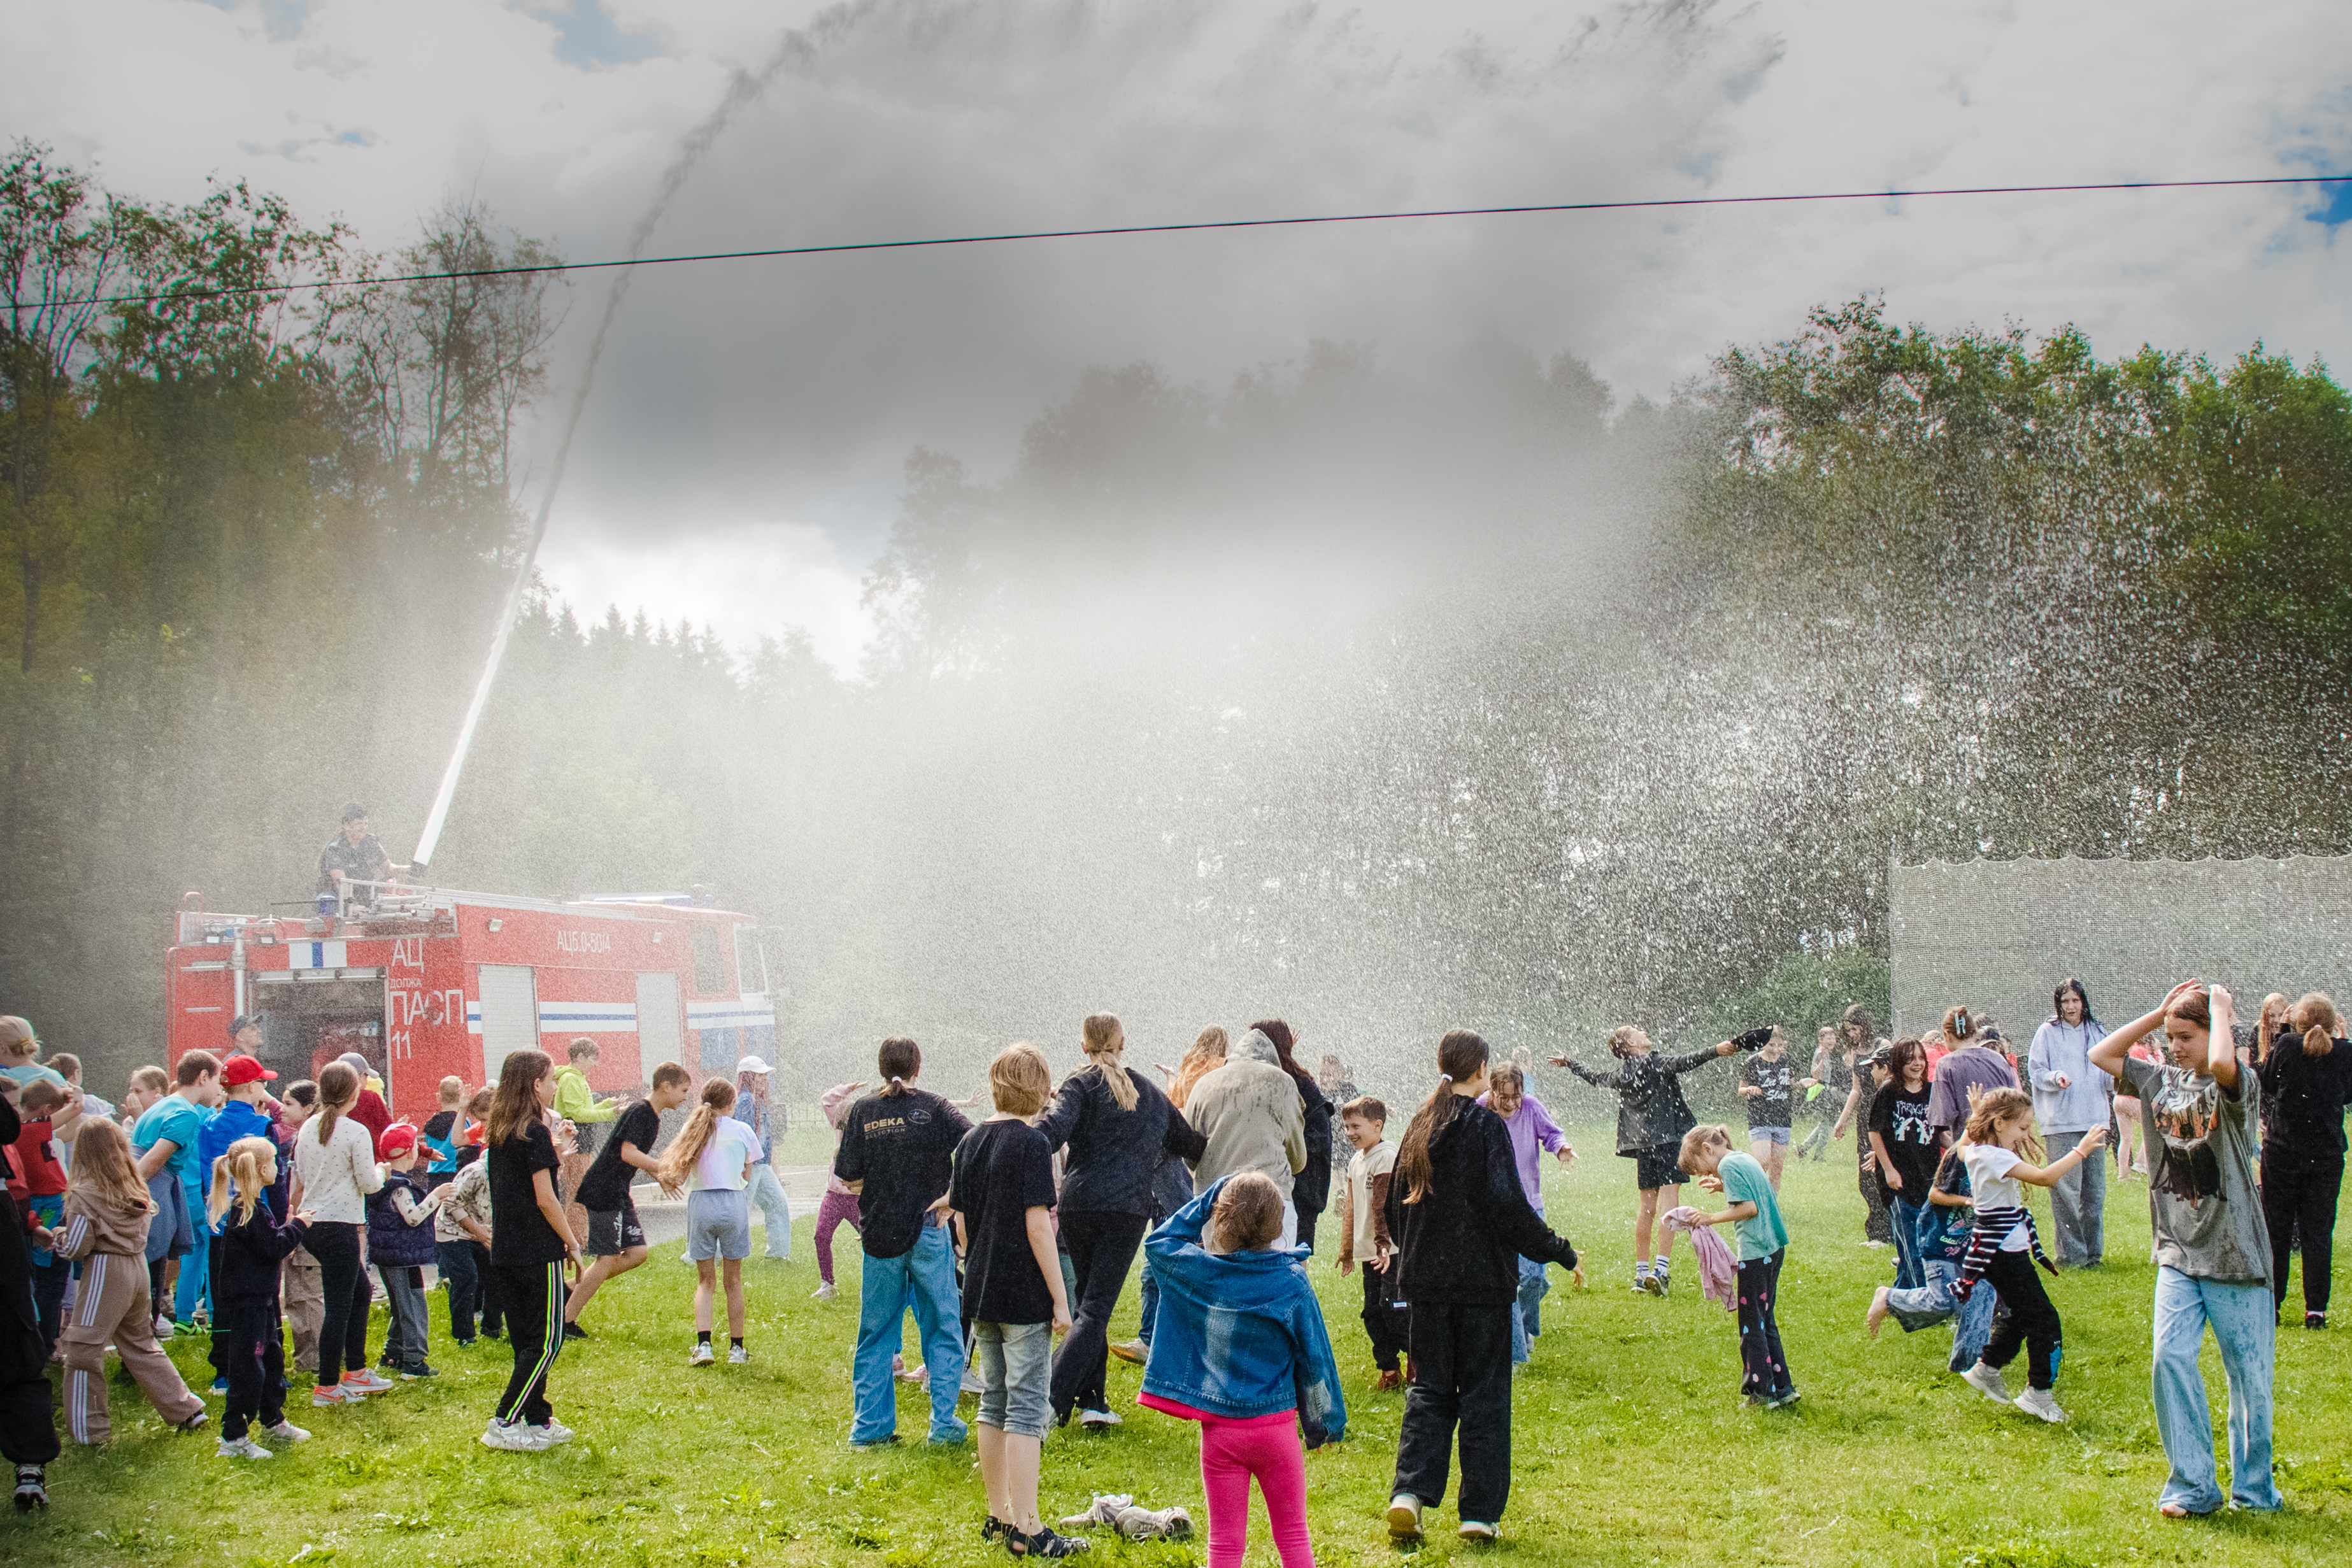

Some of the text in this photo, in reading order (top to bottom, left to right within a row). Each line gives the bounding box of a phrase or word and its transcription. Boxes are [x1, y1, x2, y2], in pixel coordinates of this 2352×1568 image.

[392, 939, 424, 973] АЦ
[390, 989, 464, 1026] ПАСП
[392, 1030, 411, 1059] 11
[864, 1117, 904, 1132] EDEKA
